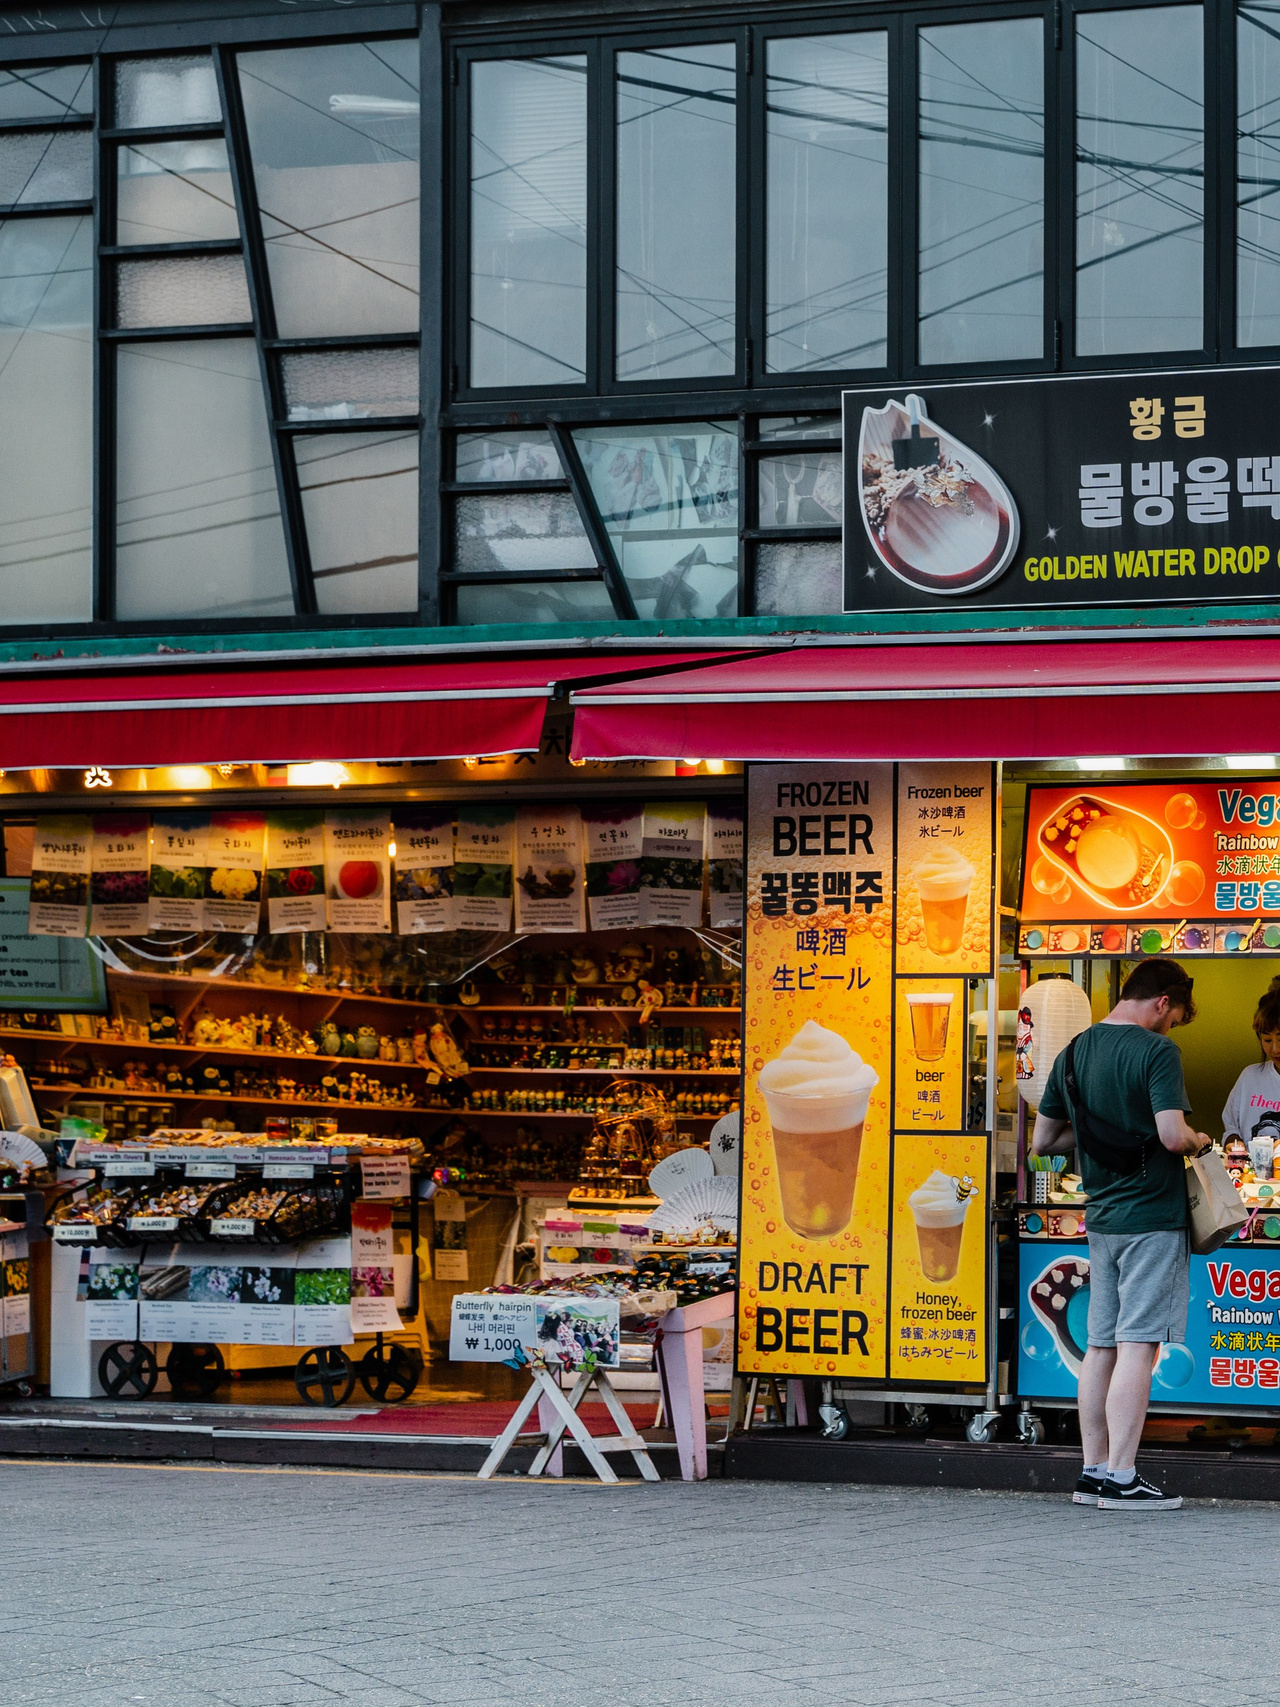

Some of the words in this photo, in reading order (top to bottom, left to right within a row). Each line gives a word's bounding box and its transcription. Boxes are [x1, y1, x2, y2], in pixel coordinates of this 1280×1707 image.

[1129, 395, 1206, 441] 황금
[1025, 548, 1108, 582] GOLDEN
[1113, 547, 1196, 577] WATER
[1203, 544, 1270, 575] DROP
[776, 780, 869, 807] FROZEN
[907, 785, 951, 800] Frozen
[954, 784, 984, 799] beer
[918, 805, 966, 820] 冰沙啤酒
[772, 813, 875, 857] BEER
[919, 824, 965, 838] 氷ビール
[1216, 832, 1280, 852] Rainbow
[760, 871, 884, 917] 꿀똥맥주
[796, 928, 847, 956] 啤酒
[772, 963, 871, 992] 生ビール
[915, 1069, 945, 1082] beer
[917, 1090, 941, 1103] 啤酒
[911, 1109, 945, 1121] ビール
[758, 1261, 870, 1295] DRAFT
[456, 1301, 494, 1311] Butterfly
[499, 1302, 531, 1312] hairpin
[916, 1292, 962, 1309] Honey,
[901, 1306, 943, 1320] frozen
[946, 1308, 977, 1321] beer
[1211, 1307, 1274, 1326] Rainbow
[468, 1322, 486, 1334] 나비
[488, 1323, 515, 1334] 머리핀
[755, 1307, 870, 1356] BEER
[465, 1337, 479, 1350] ₩
[484, 1338, 521, 1352] 1,000
[898, 1345, 979, 1360] はちみつビール
